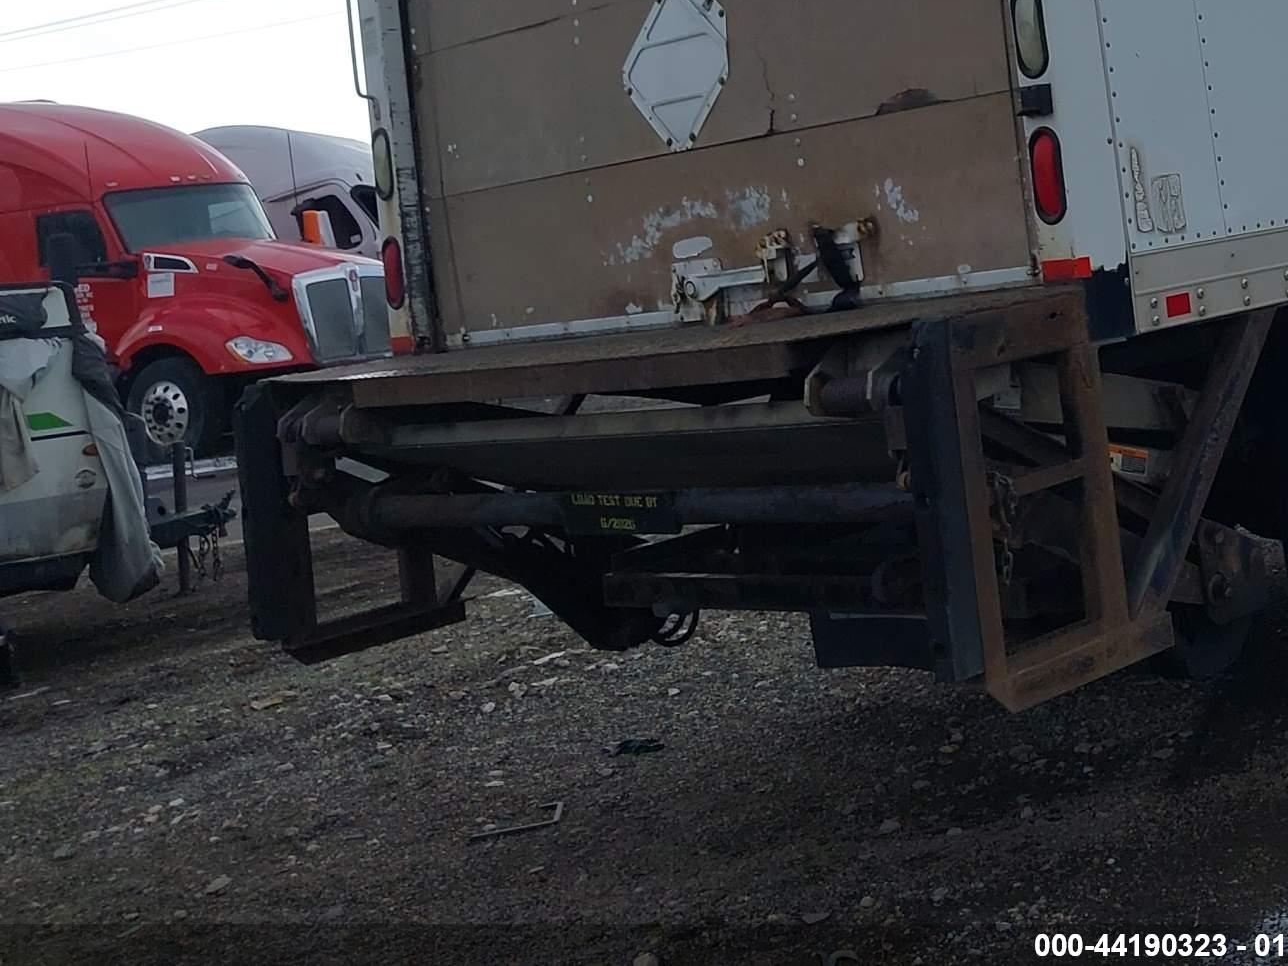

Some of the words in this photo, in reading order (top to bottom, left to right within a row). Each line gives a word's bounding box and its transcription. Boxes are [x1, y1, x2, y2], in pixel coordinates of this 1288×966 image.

[570, 492, 596, 506] LOAD
[597, 494, 621, 507] TEST
[623, 495, 644, 508] DUE
